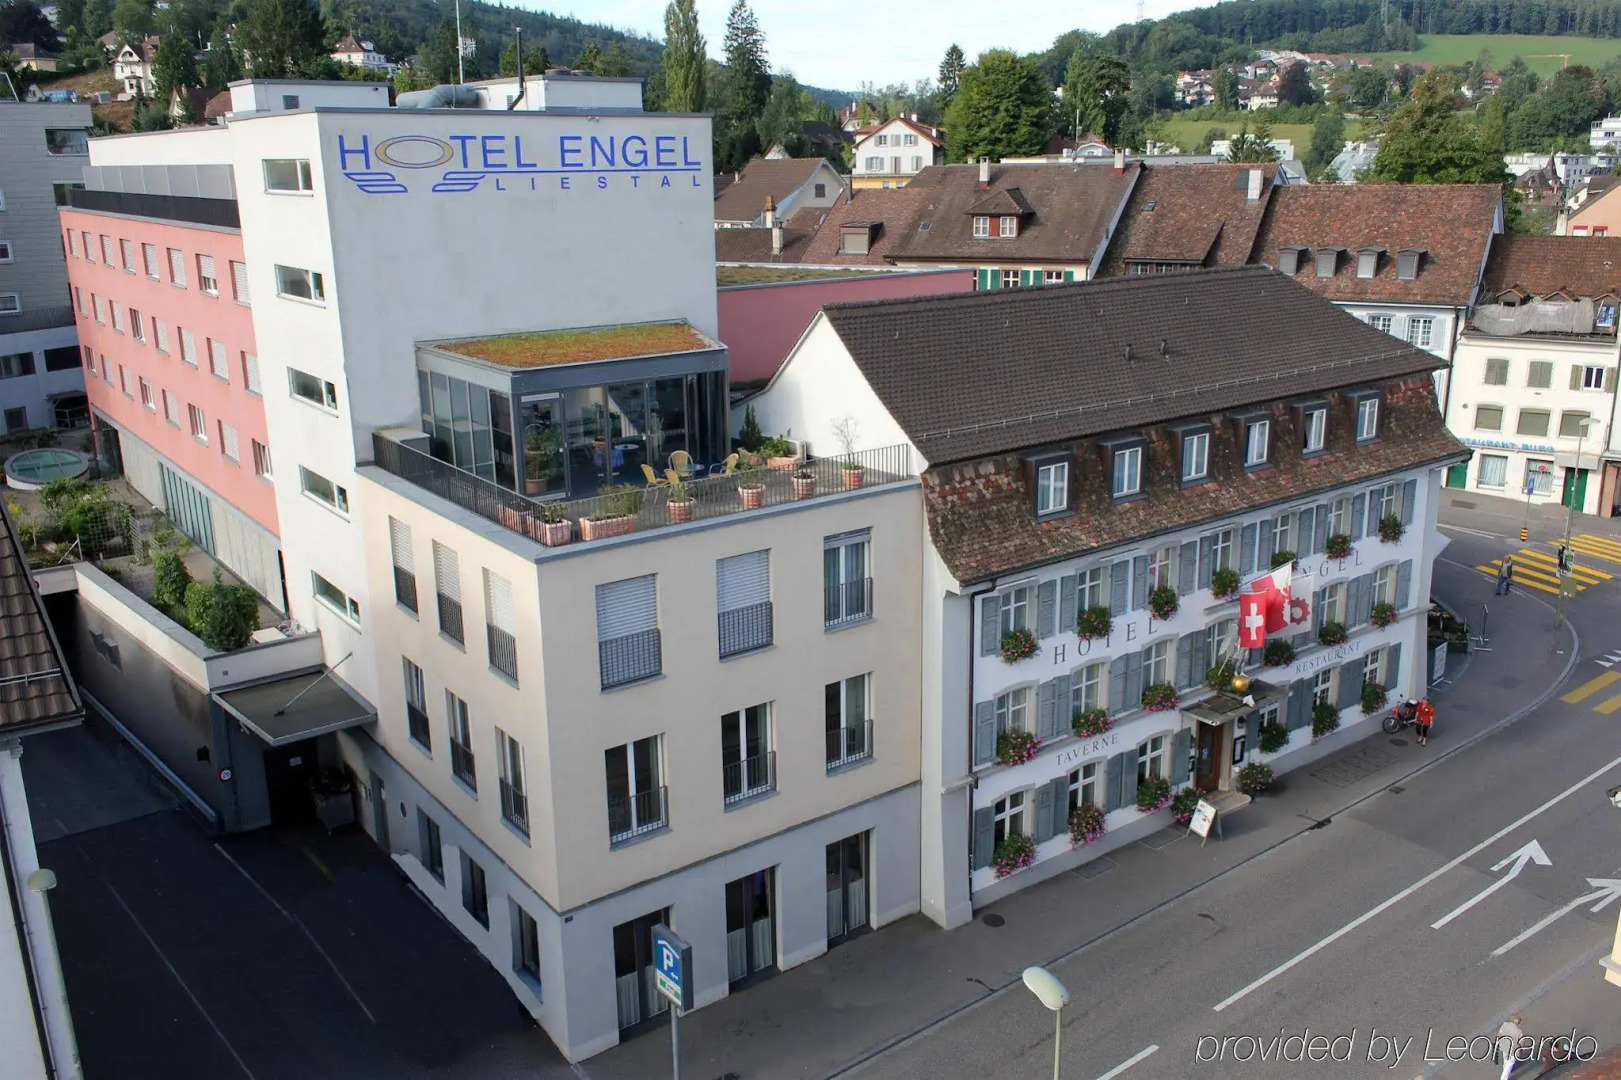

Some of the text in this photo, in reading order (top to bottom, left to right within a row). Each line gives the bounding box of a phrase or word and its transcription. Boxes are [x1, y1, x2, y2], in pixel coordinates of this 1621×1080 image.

[338, 134, 702, 171] HOTEL ENGEL
[495, 174, 701, 191] LIESTAL
[1301, 549, 1363, 578] NGEL
[1296, 640, 1361, 675] RESTAURANT
[1056, 732, 1119, 766] TAVERNE
[662, 946, 674, 971] P
